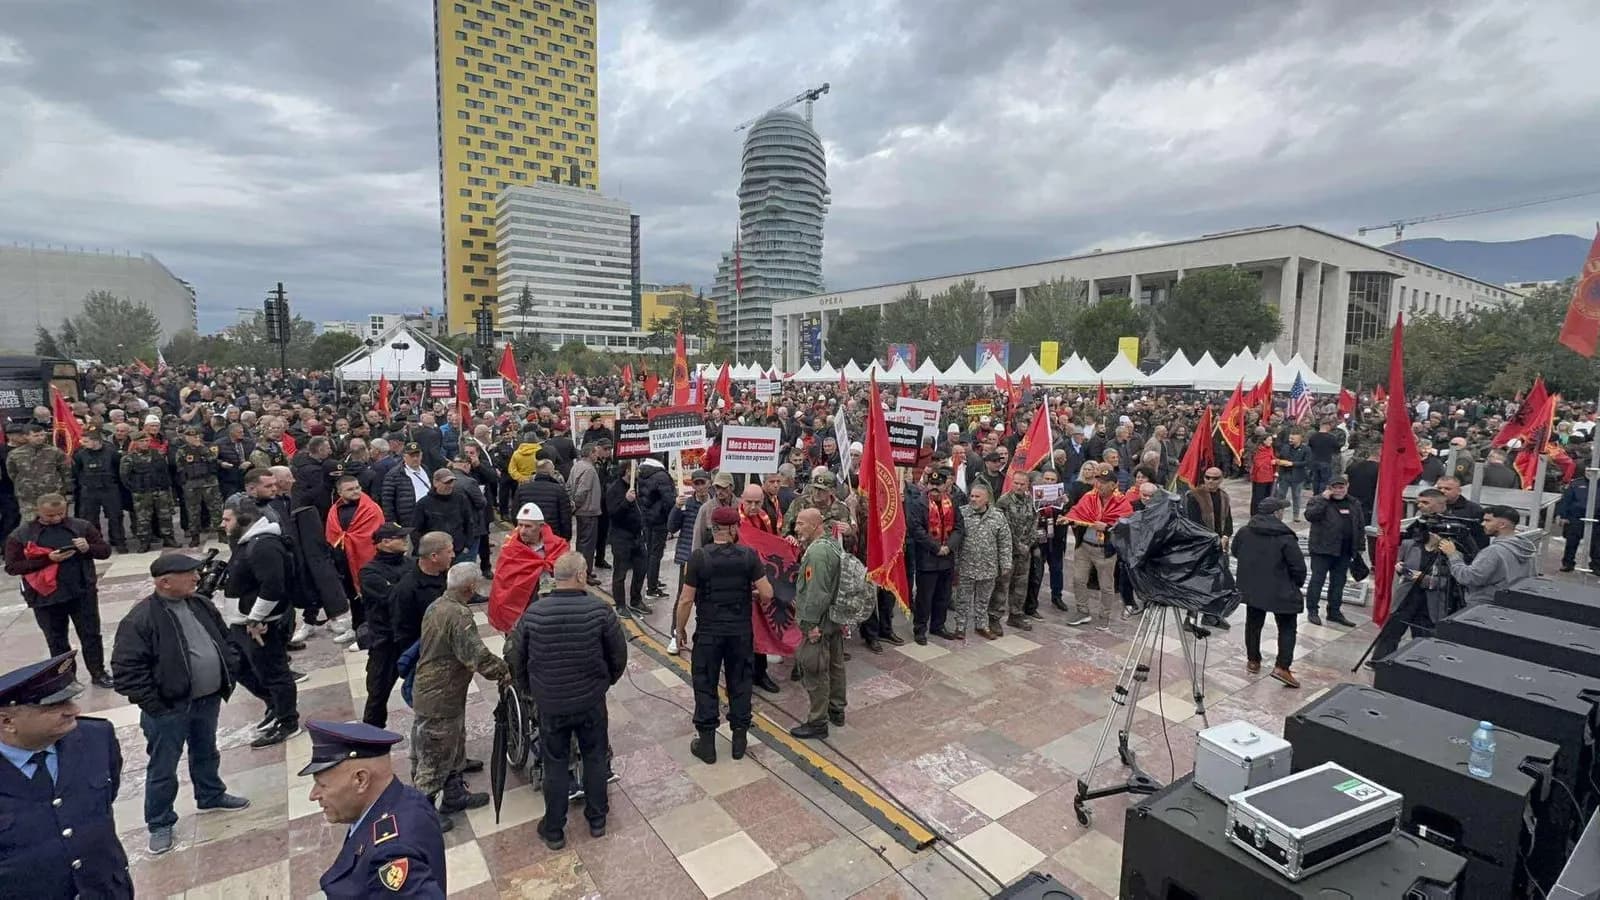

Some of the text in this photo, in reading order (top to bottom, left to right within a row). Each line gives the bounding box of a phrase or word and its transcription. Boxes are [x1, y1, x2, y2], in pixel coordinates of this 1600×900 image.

[819, 296, 843, 305] OPERA
[728, 440, 742, 449] Mos
[748, 440, 774, 450] barazoni
